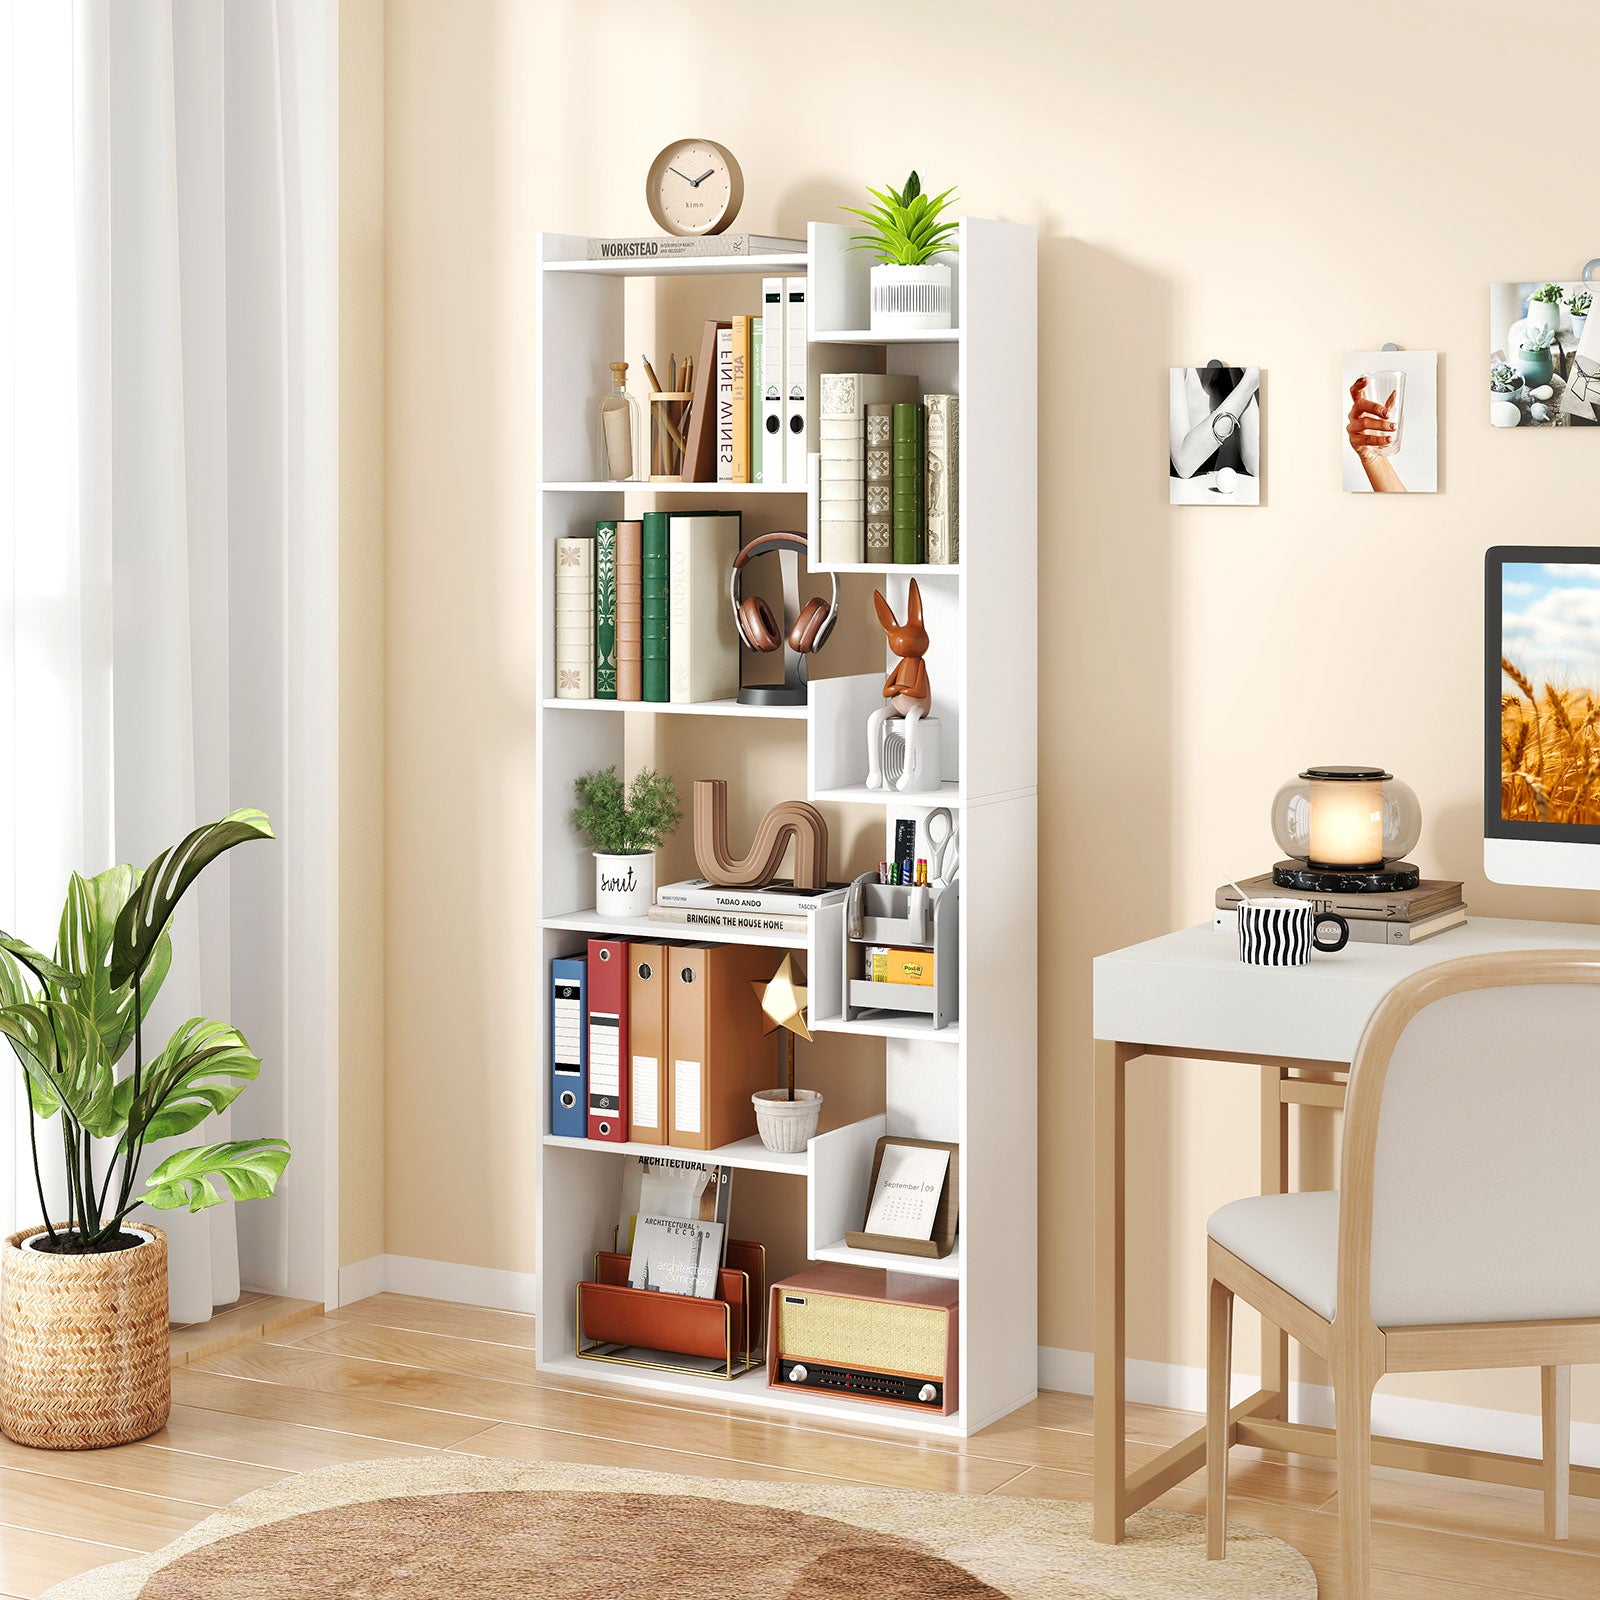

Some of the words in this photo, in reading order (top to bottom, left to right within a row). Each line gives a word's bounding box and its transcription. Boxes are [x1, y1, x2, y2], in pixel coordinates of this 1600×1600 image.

[601, 242, 658, 257] WORKSTEAD
[674, 551, 685, 625] LUXDECO
[716, 897, 740, 906] TADAO
[741, 899, 762, 908] ANDO
[686, 913, 721, 925] BRINGING
[722, 916, 737, 927] THE
[737, 917, 762, 929] HOUSE
[763, 919, 784, 930] HOME
[638, 1156, 707, 1172] ARCHITECTURAL
[883, 1180, 920, 1191] September
[644, 1218, 695, 1230] ARCHITECTURAL
[666, 1227, 710, 1239] RECORD
[657, 1256, 713, 1276] architecture
